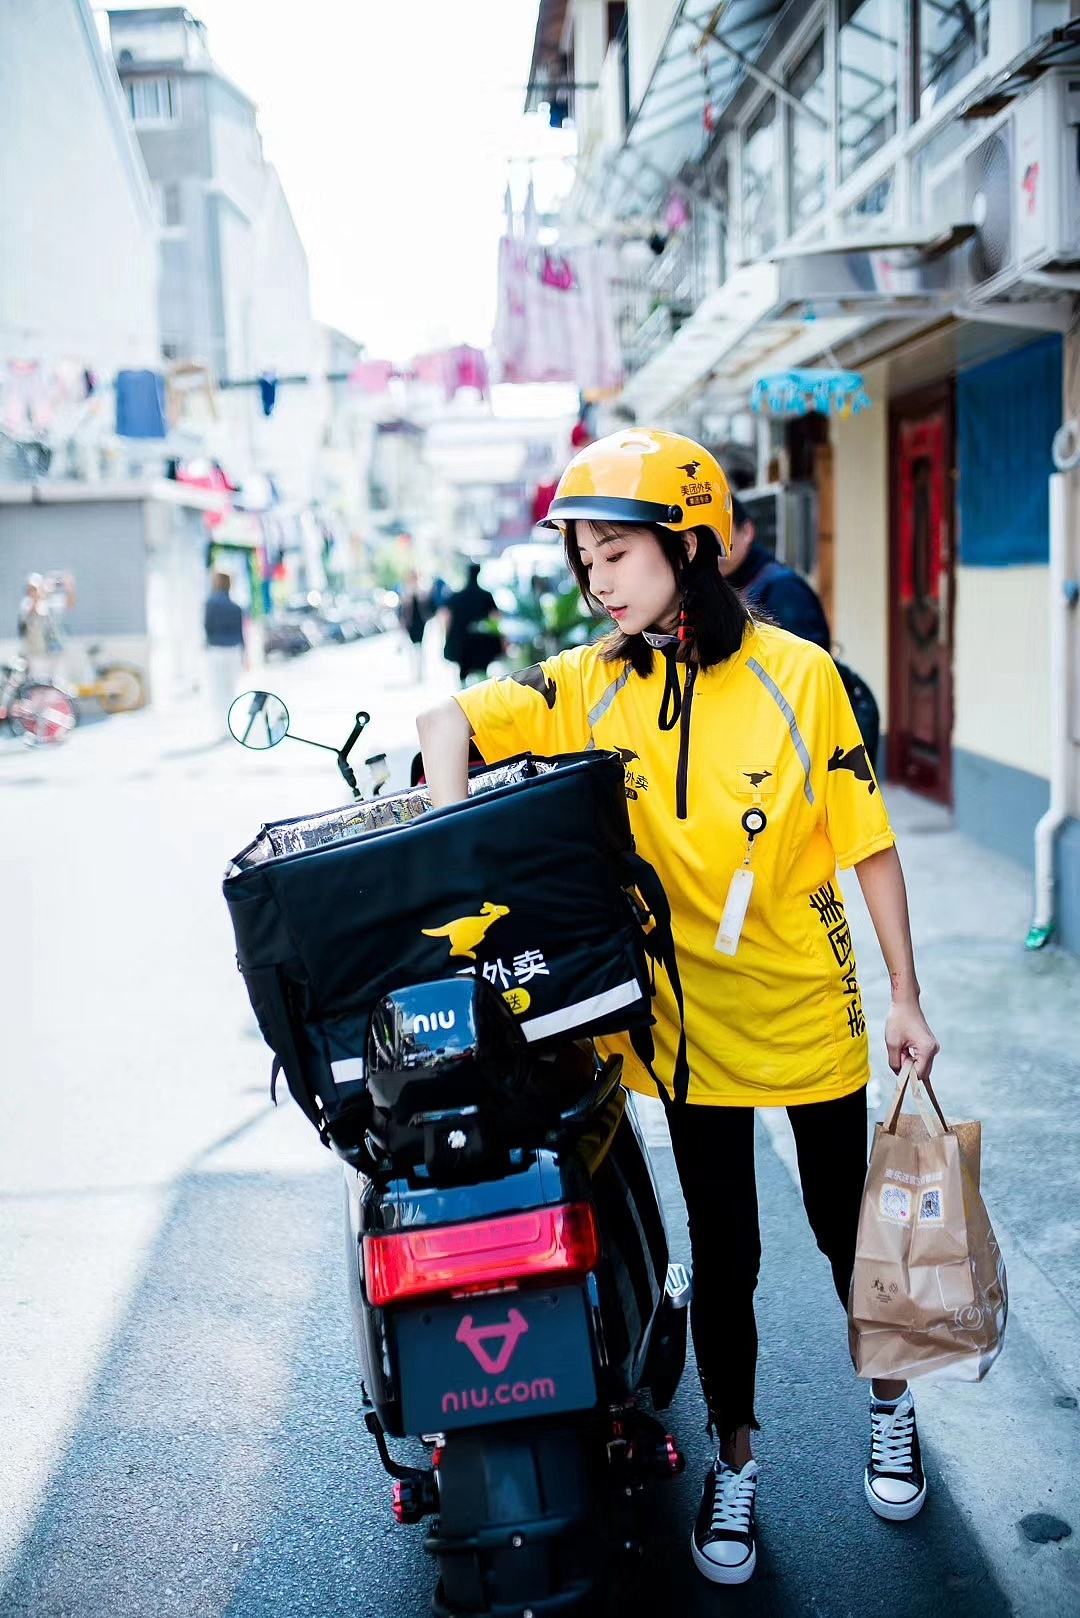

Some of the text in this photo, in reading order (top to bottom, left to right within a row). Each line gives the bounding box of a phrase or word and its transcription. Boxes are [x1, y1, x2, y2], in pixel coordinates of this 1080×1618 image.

[680, 481, 713, 497] 美团外卖
[455, 948, 550, 989] 外卖
[441, 1377, 557, 1414] niu.com
